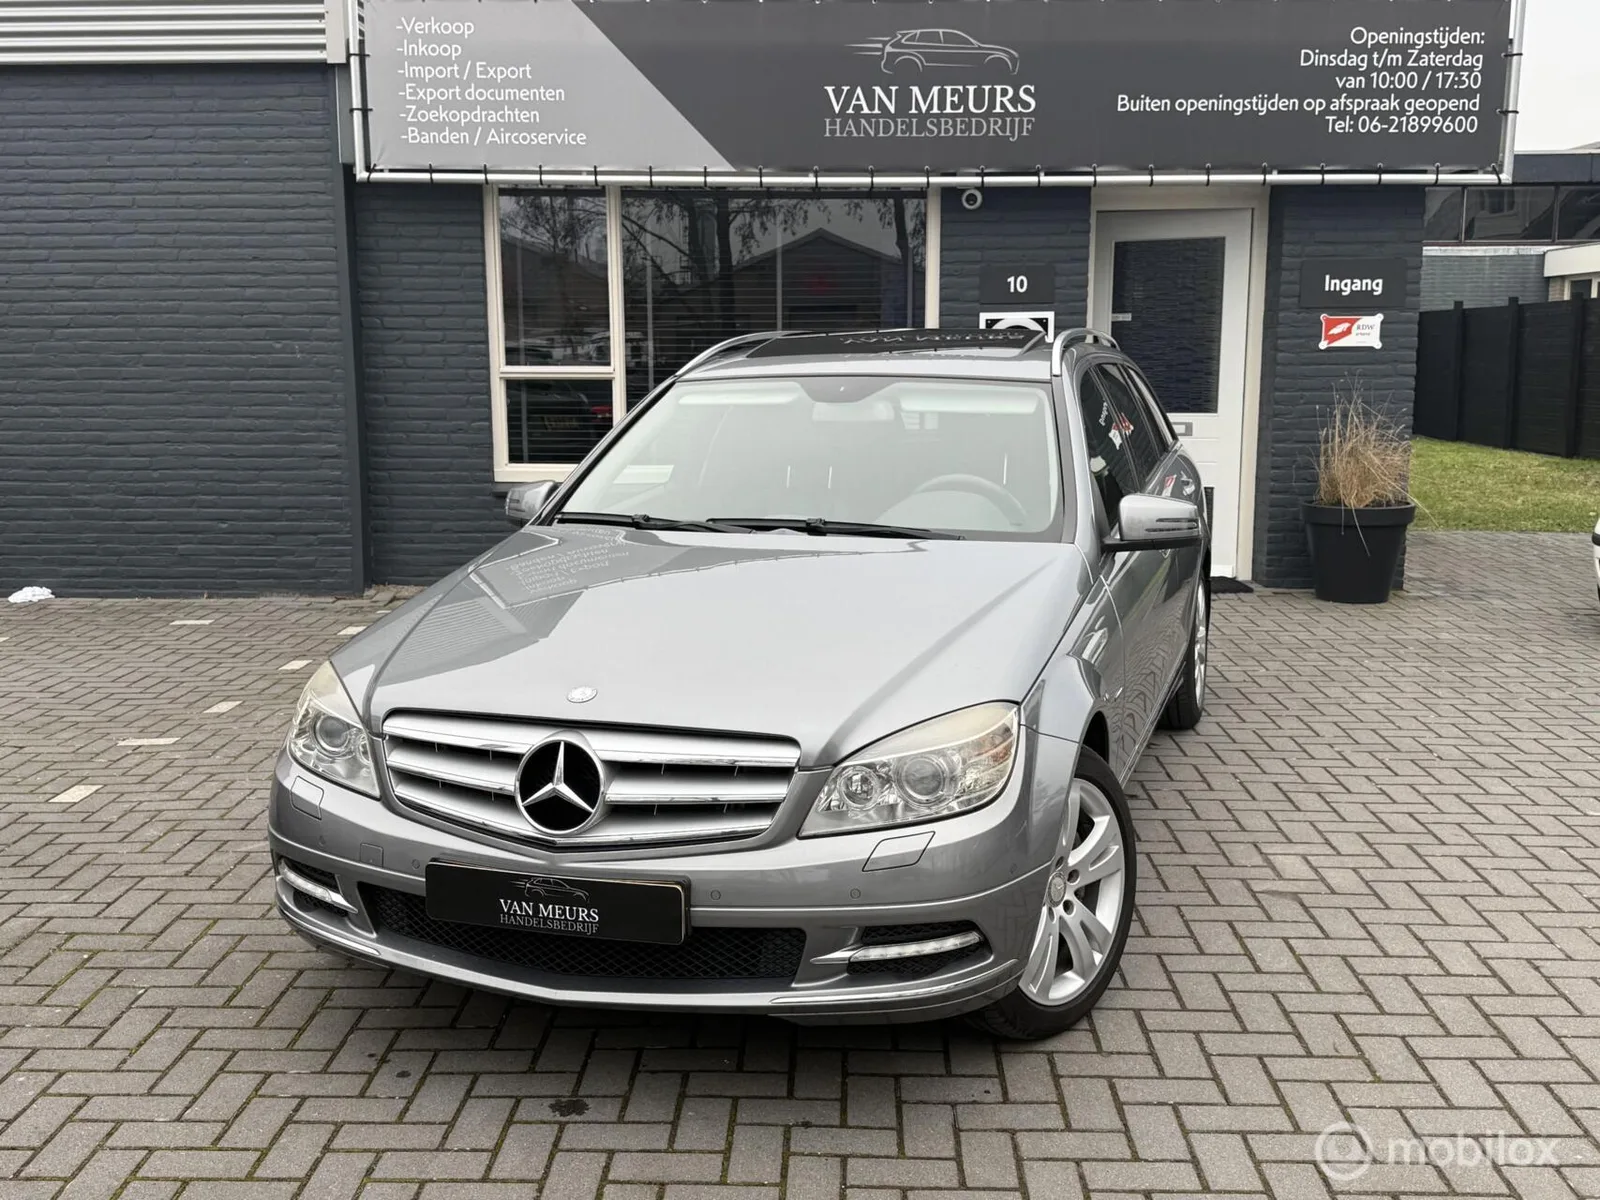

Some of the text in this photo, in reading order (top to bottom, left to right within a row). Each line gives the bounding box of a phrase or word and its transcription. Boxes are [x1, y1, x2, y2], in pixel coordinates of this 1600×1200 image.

[396, 17, 475, 38] -Verkoop
[1350, 26, 1486, 48] Openingstijden:
[397, 39, 462, 60] -Inkoop
[1300, 49, 1484, 70] Dinsdag t/m Zaterdag
[398, 61, 532, 83] -Import / Export
[1335, 70, 1482, 91] van 10:00 / 17:30
[398, 84, 565, 104] -Export documenten
[824, 84, 1037, 114] VAN MEURS
[1116, 94, 1481, 115] Buiten openingstijden op afspraak geopend
[400, 106, 540, 127] -Zoekopdrachten
[1325, 115, 1479, 134] Tel: 06-21899600
[401, 126, 587, 146] -Banden / Aircoservice
[823, 117, 1036, 142] HANDELSBEDRIJF
[1006, 275, 1028, 293] 10
[1324, 274, 1384, 296] Ingang
[499, 898, 600, 923] VAN MEURS
[499, 914, 599, 935] HANDELSBEDRIJF
